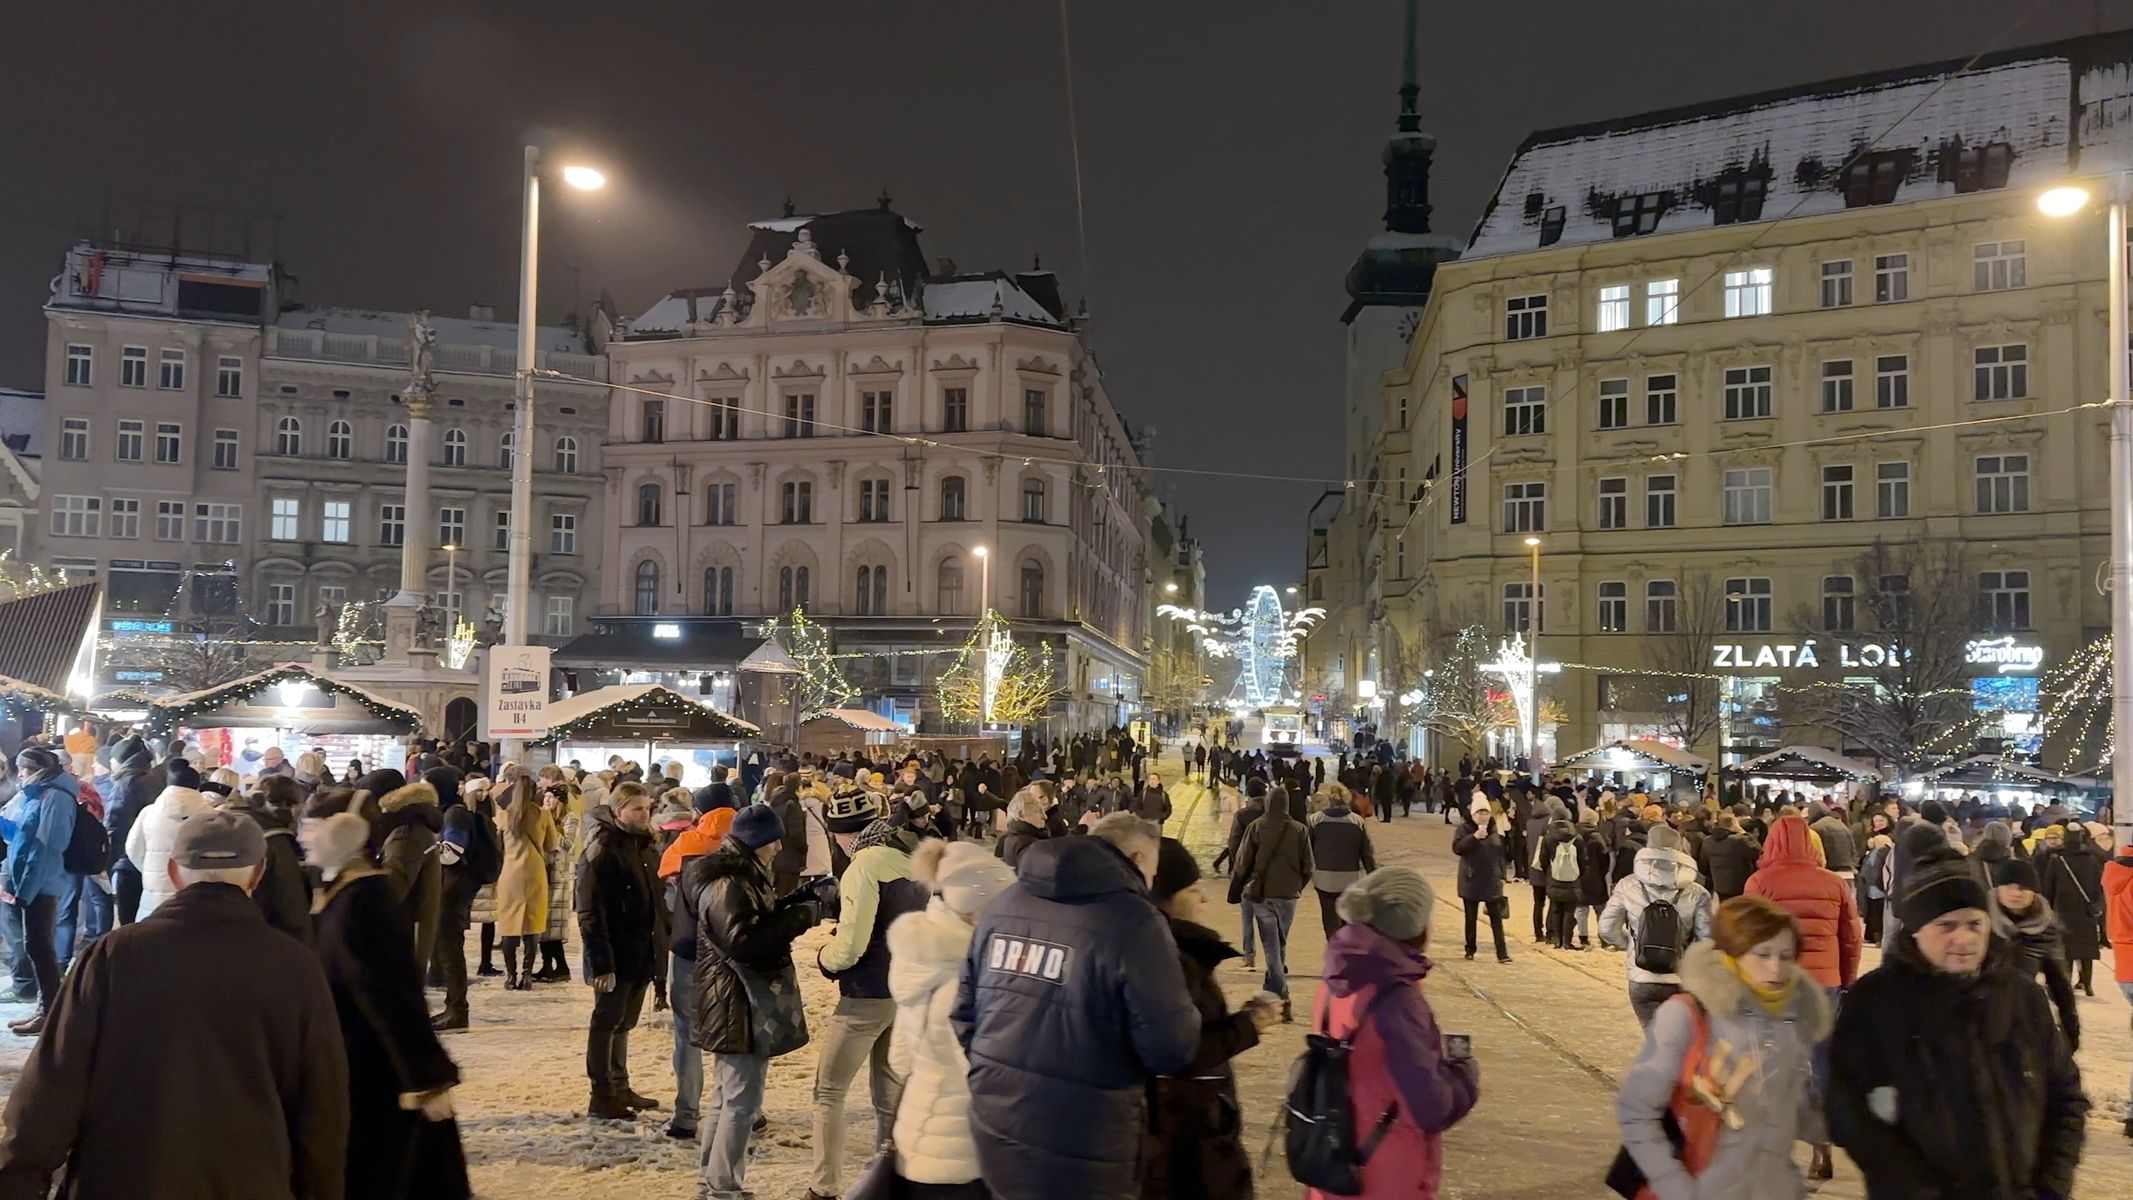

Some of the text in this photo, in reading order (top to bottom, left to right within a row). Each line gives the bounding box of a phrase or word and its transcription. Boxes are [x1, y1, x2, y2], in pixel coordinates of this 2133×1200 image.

[1713, 639, 1820, 667] ZLATÁ
[513, 712, 526, 724] H4
[990, 938, 1065, 980] BRNO
